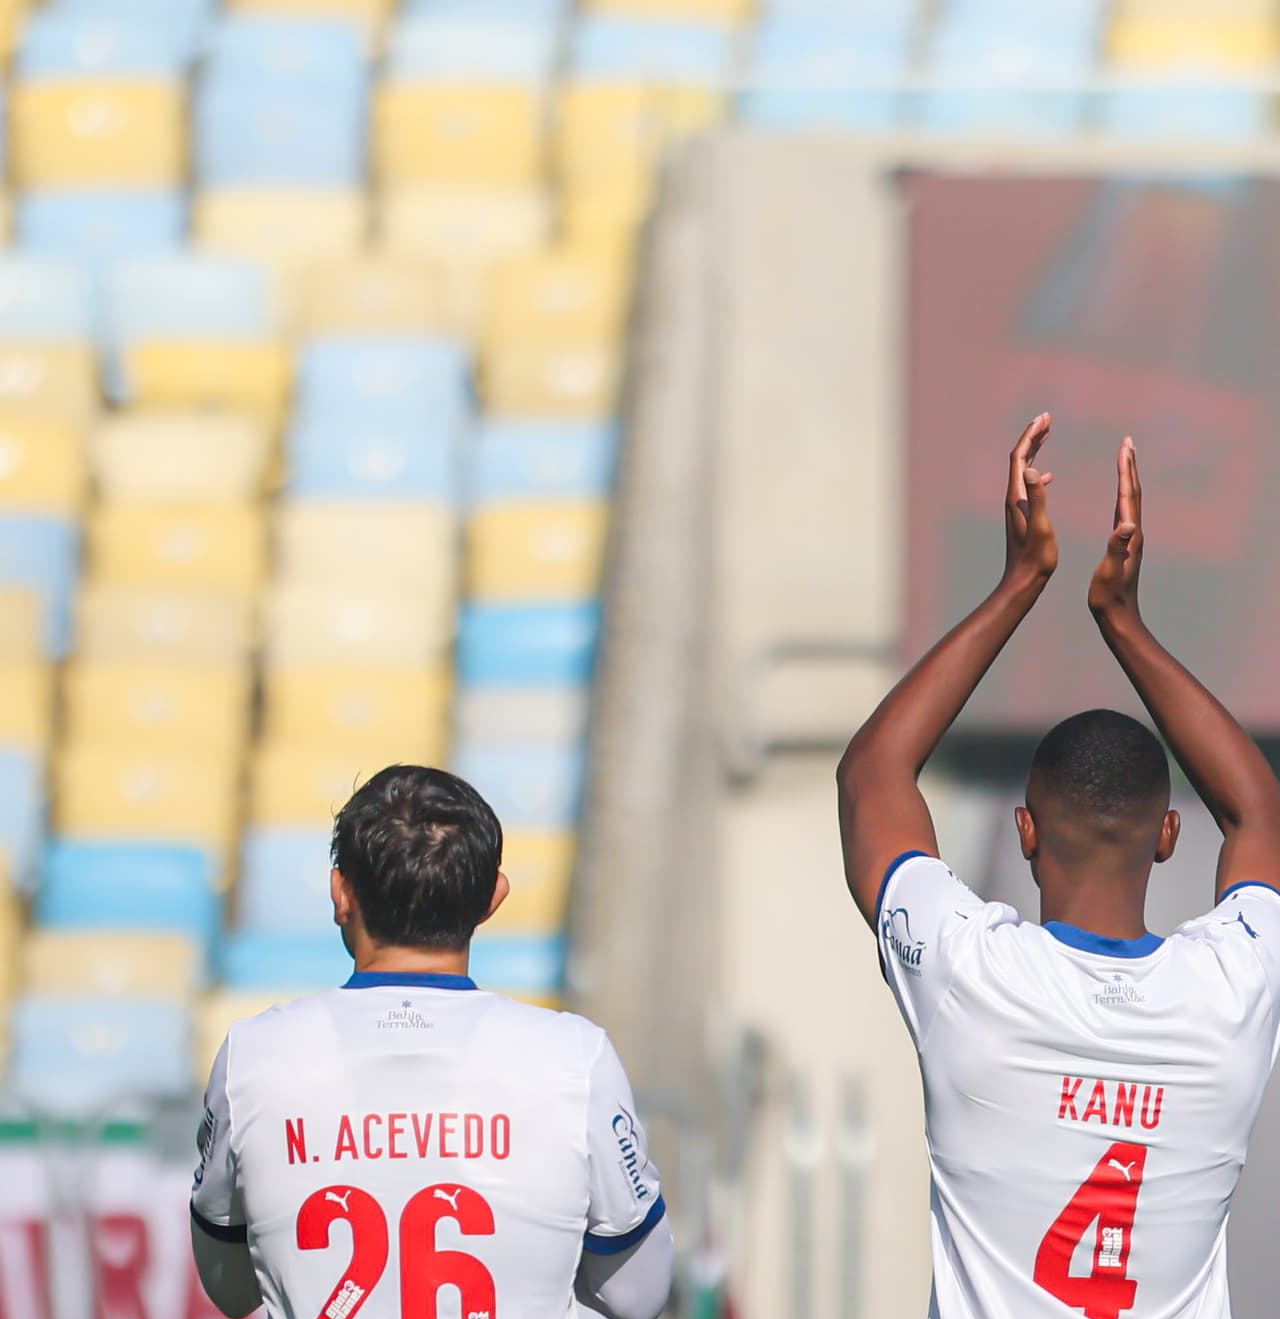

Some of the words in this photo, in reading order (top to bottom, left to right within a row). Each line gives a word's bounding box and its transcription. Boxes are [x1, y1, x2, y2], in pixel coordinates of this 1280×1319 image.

[1058, 1075, 1165, 1131] KANU
[285, 1117, 320, 1165] N.
[334, 1112, 511, 1162] ACEVEDO
